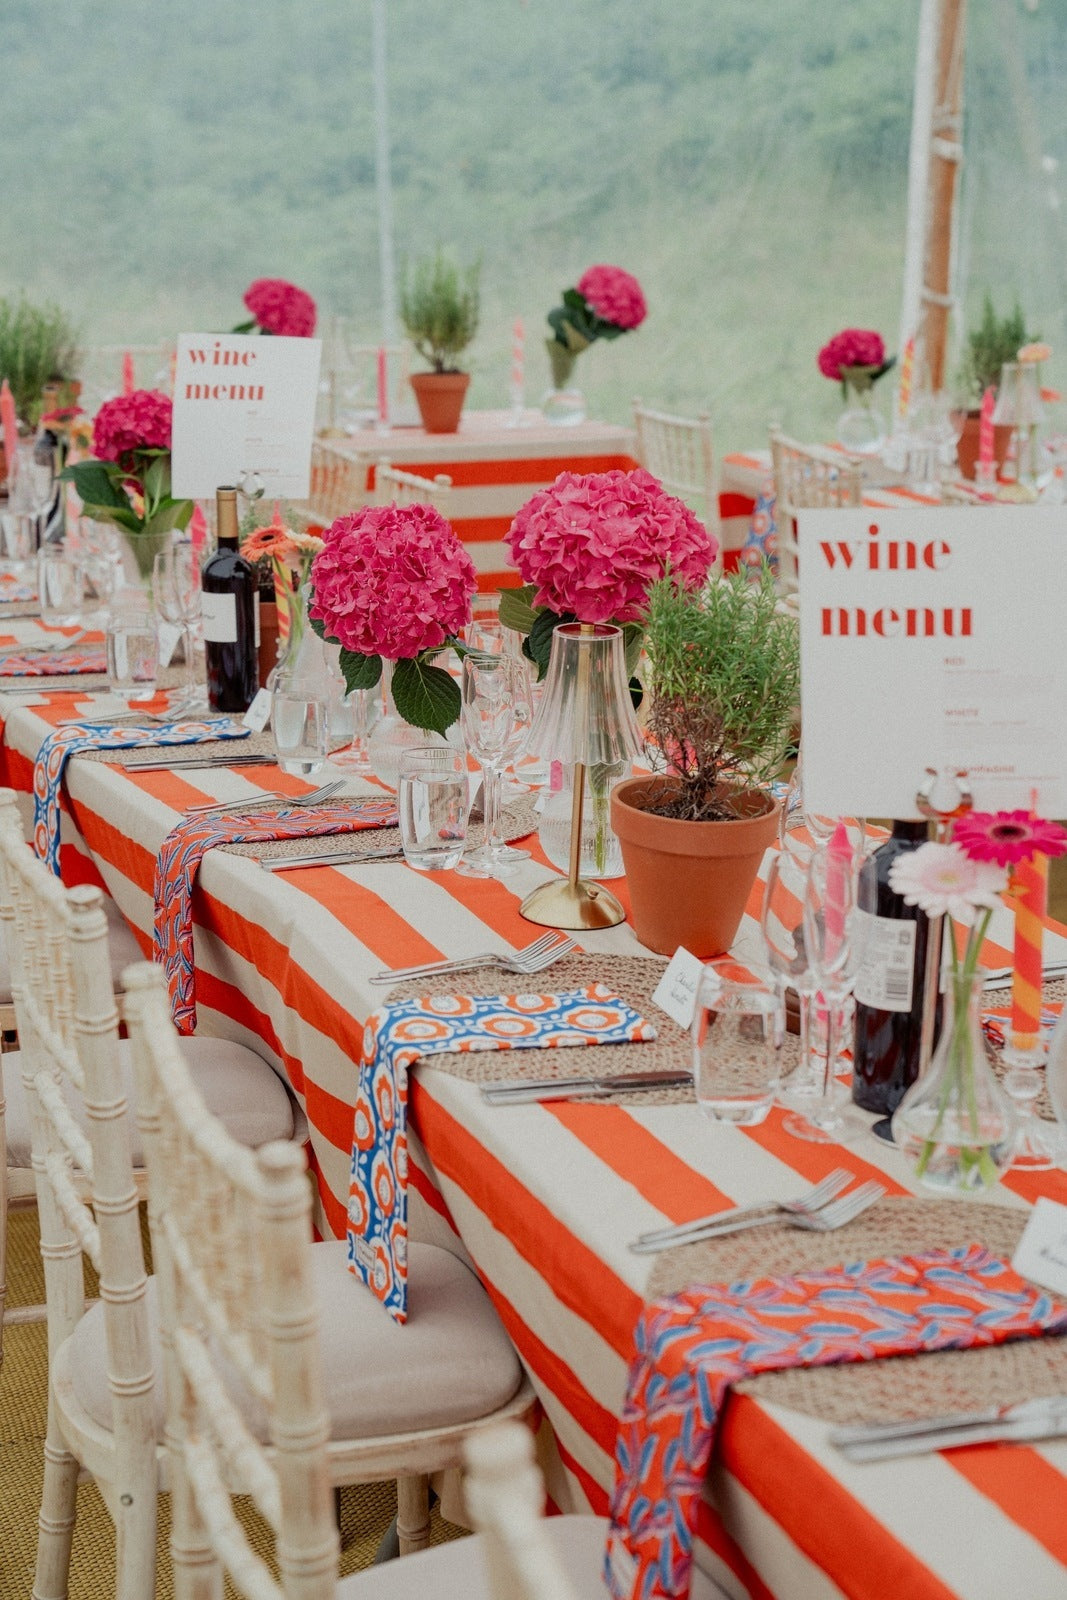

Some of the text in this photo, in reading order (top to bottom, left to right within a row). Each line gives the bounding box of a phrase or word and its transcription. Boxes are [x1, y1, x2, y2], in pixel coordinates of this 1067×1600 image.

[189, 341, 257, 366] wine
[185, 384, 264, 400] menu
[819, 523, 953, 571] wine
[820, 607, 974, 638] menu
